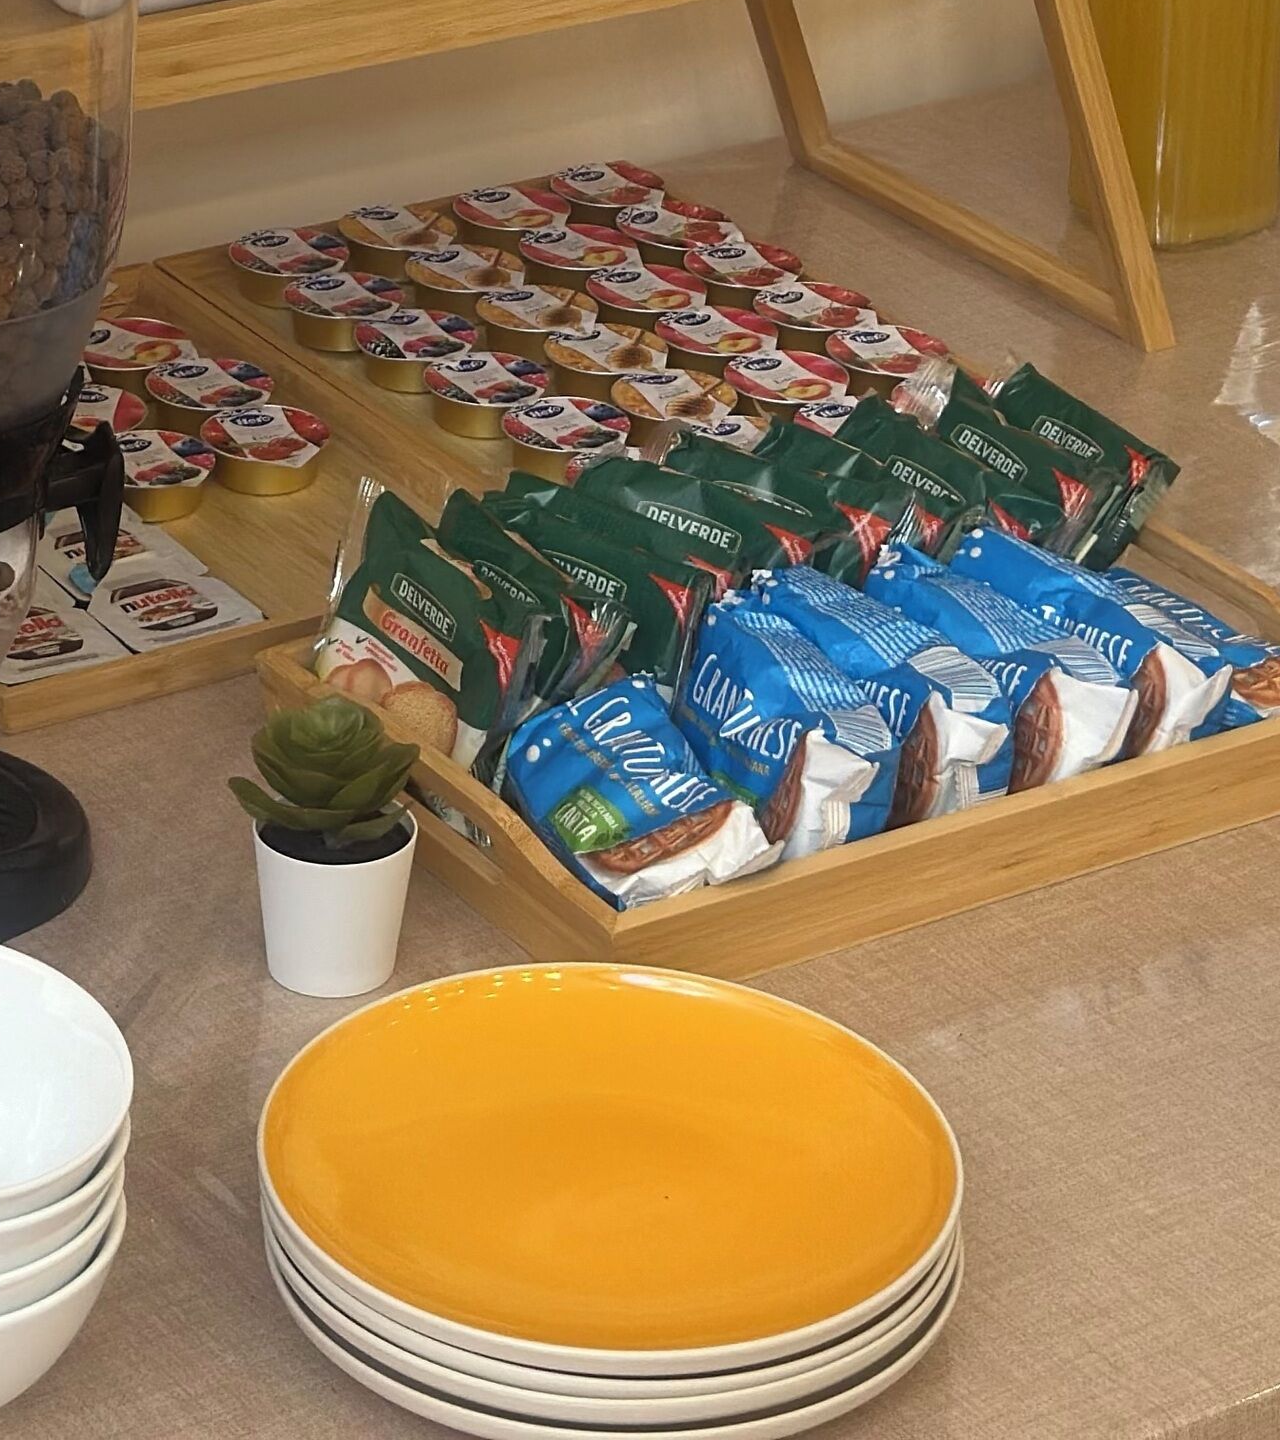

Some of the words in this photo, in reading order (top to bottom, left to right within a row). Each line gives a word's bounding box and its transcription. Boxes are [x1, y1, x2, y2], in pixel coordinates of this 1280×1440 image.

[236, 416, 271, 427] Hero
[1038, 420, 1099, 459] DELVERDE
[958, 428, 1023, 480] DELVERDE
[121, 585, 199, 614] nutella
[398, 578, 452, 637] DELVERDE
[380, 610, 450, 676] Granfetta
[554, 802, 598, 844] CARTA
